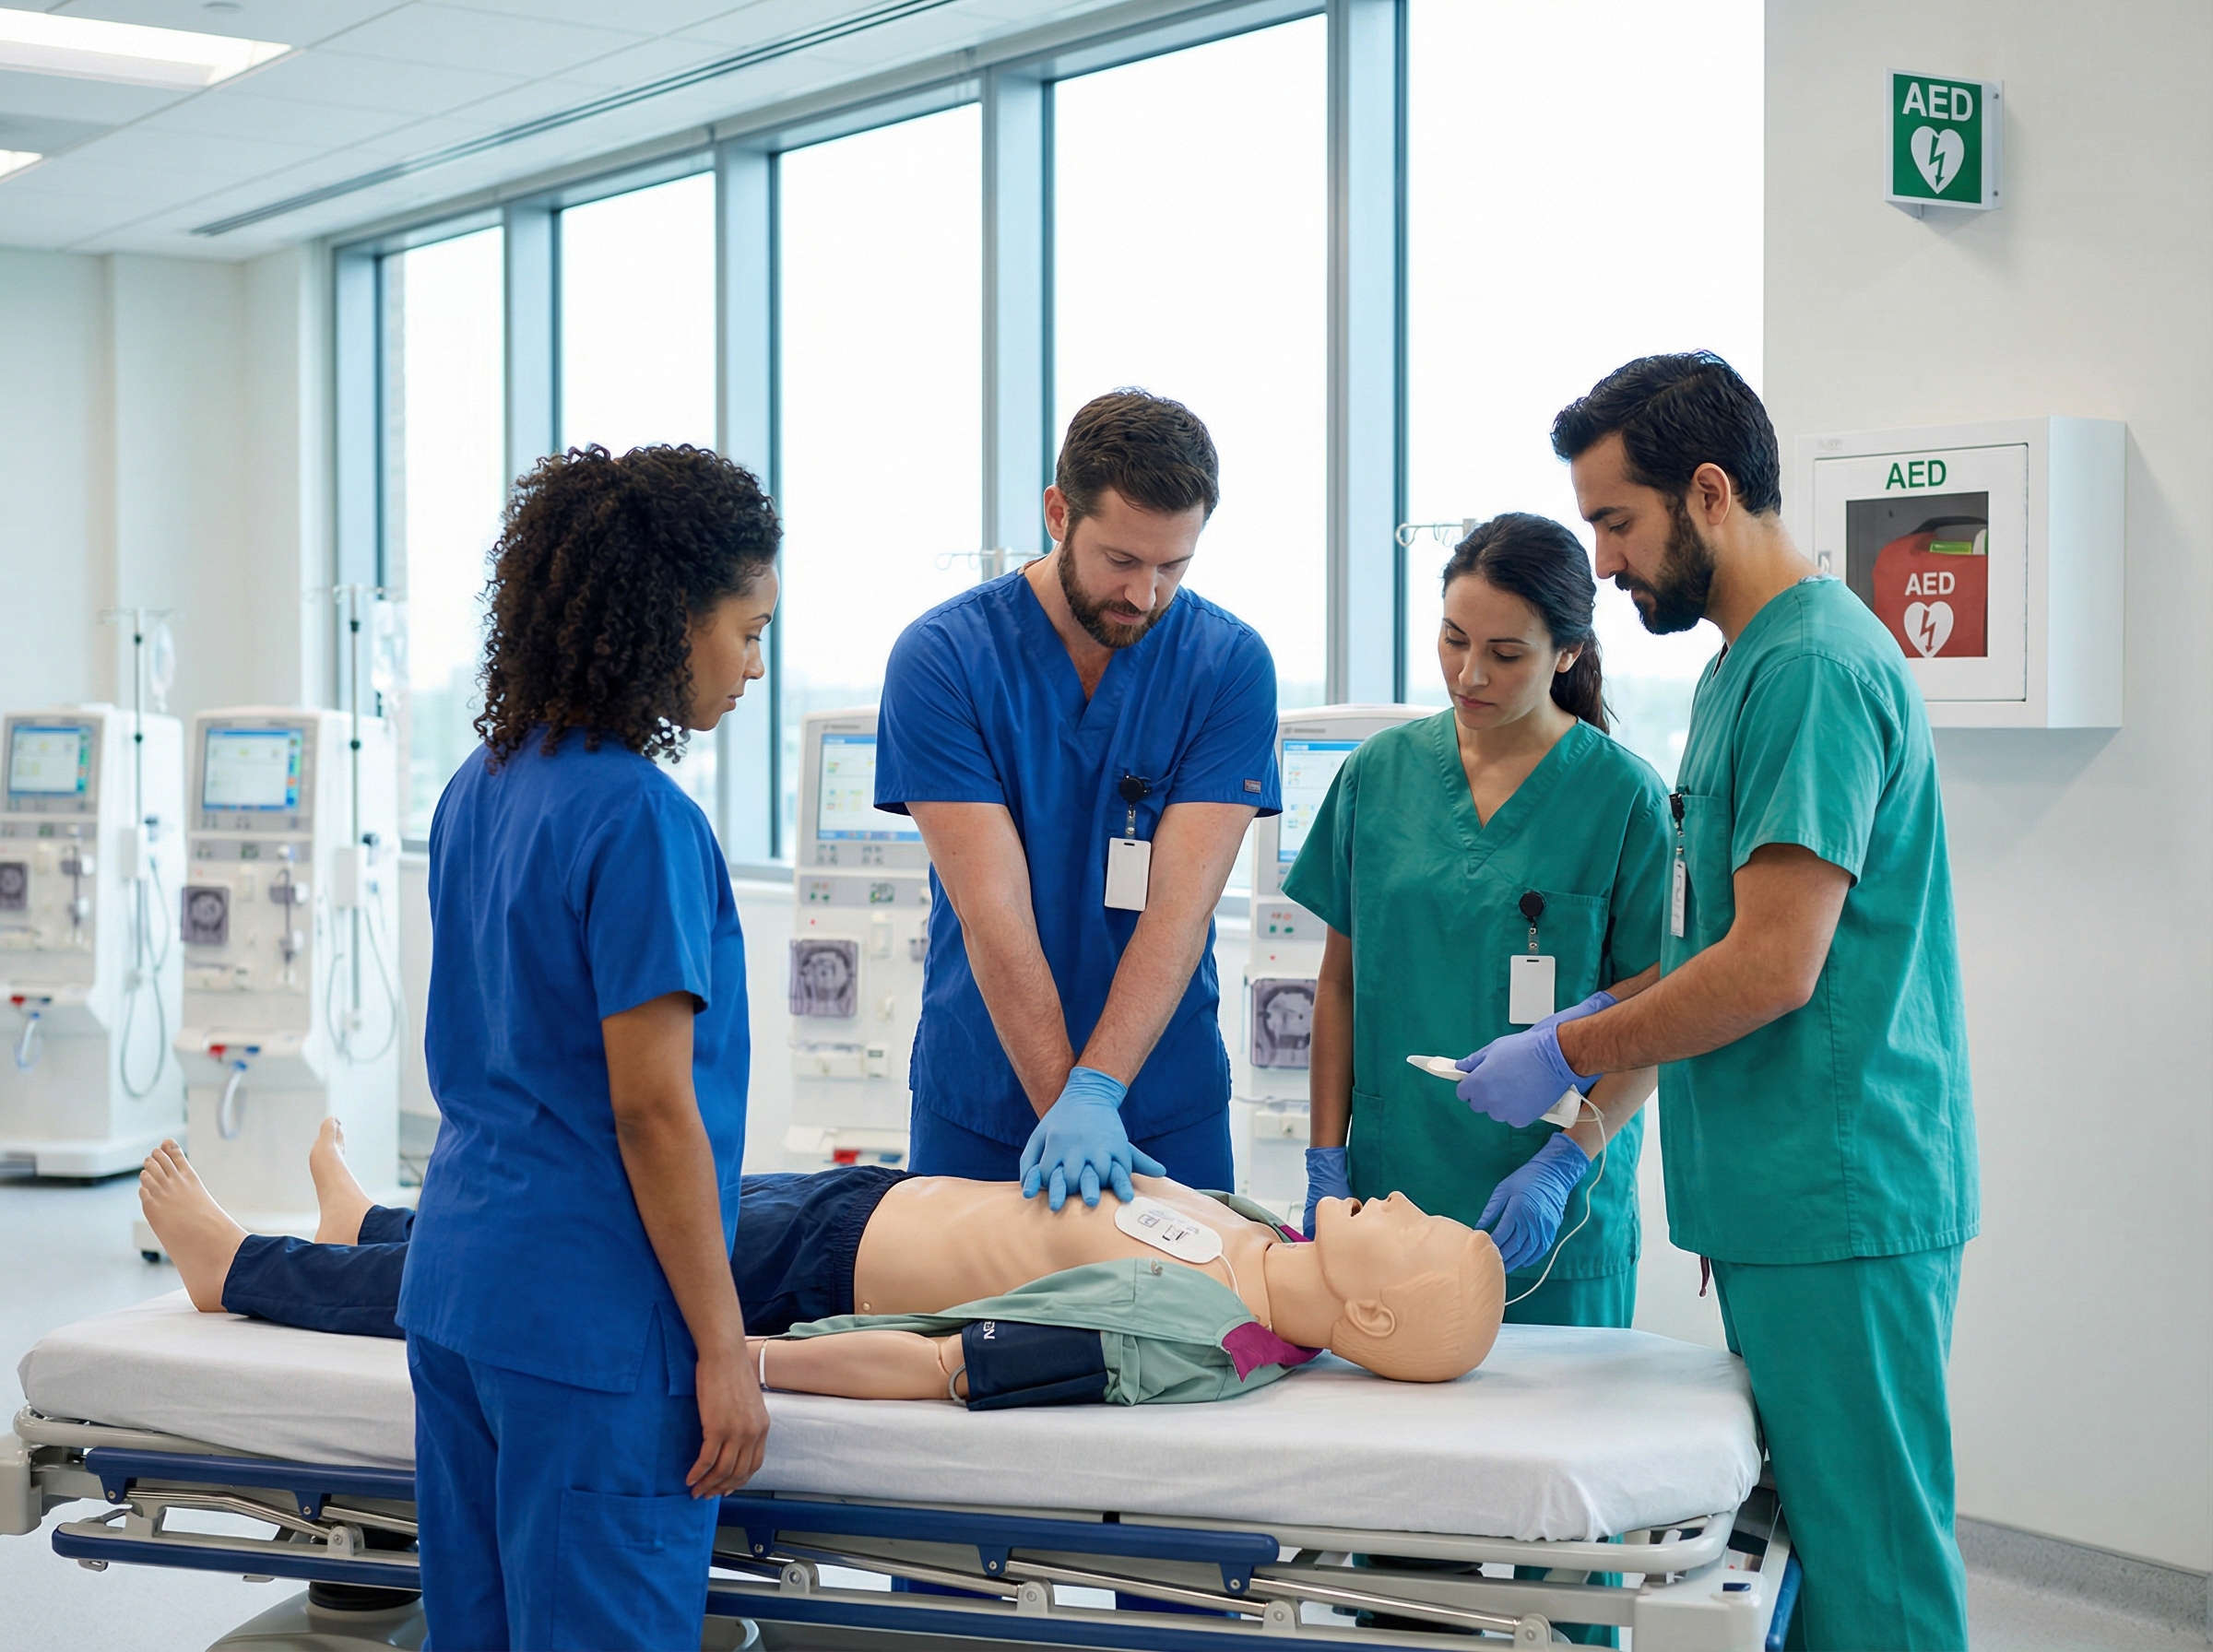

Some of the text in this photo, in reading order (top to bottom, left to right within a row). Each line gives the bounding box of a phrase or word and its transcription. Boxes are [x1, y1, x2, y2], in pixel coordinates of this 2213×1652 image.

[1902, 82, 1973, 122] AED
[1886, 459, 1947, 490] AED
[1904, 572, 1956, 596] AED
